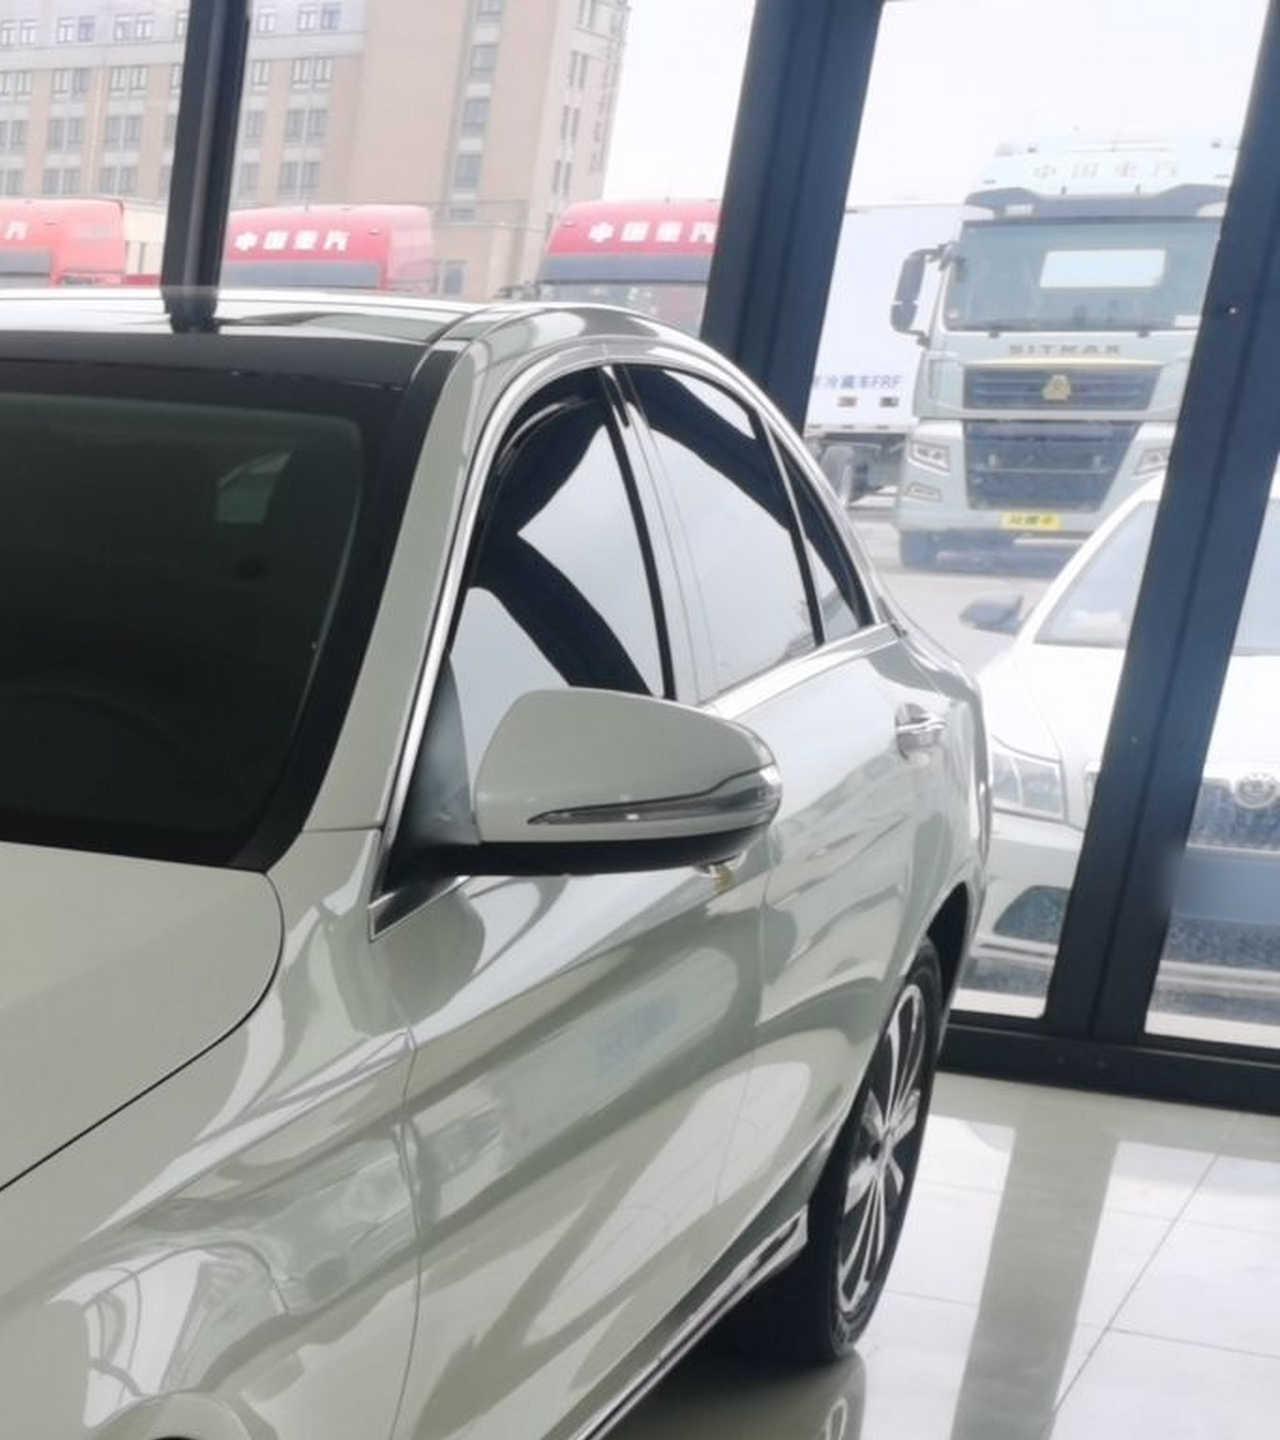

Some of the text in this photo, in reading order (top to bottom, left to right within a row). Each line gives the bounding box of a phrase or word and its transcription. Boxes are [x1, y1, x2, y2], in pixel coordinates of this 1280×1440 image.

[1033, 161, 1176, 180] 中国重汽
[234, 230, 350, 251] 中国重汽
